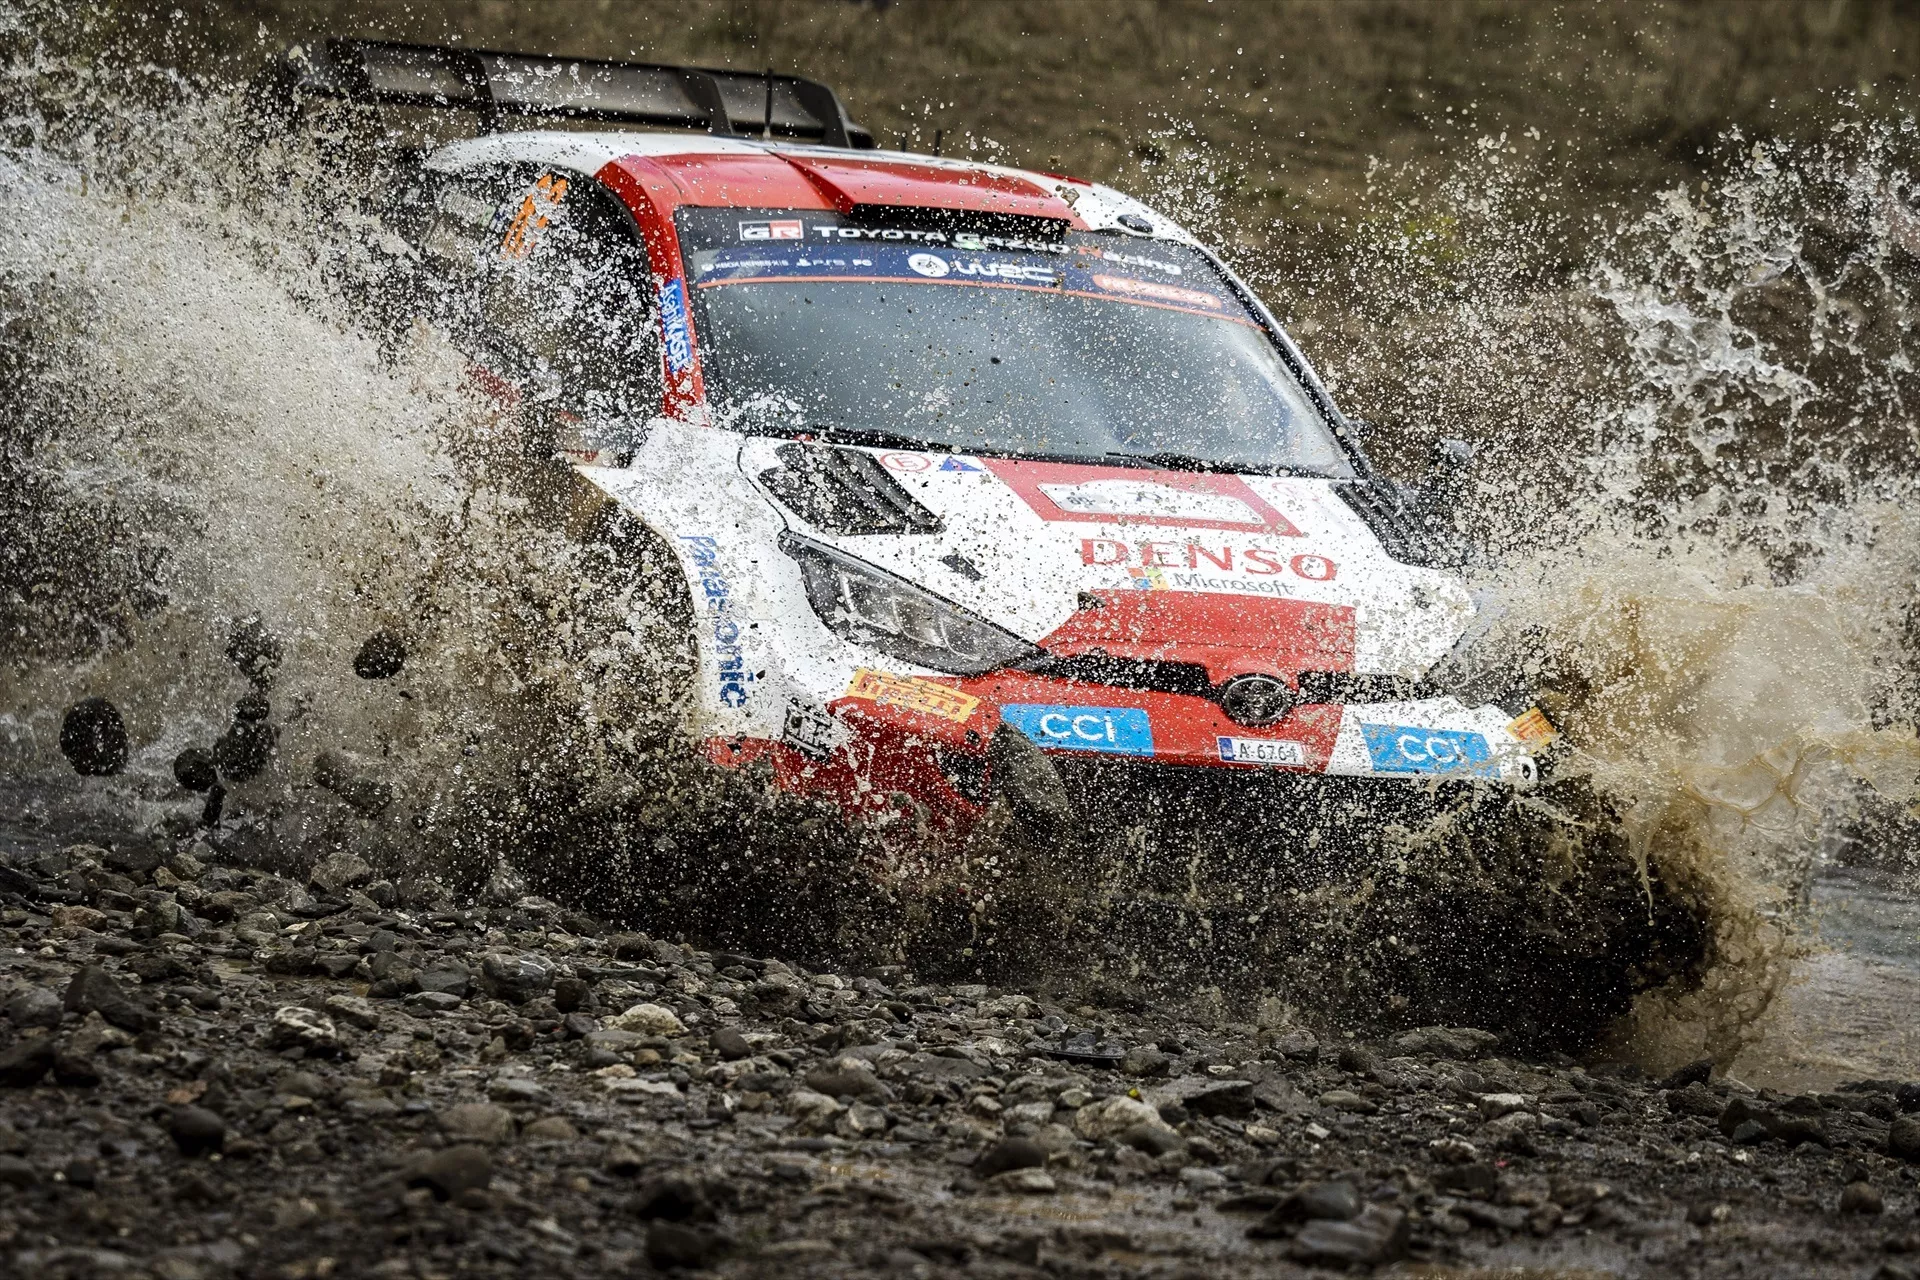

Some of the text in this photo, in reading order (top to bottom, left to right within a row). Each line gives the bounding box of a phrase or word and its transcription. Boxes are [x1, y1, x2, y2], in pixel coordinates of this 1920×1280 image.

[742, 225, 801, 239] GR
[812, 225, 948, 242] TOYOTA
[1081, 538, 1338, 582] DENSO
[1172, 572, 1295, 597] Microsoft
